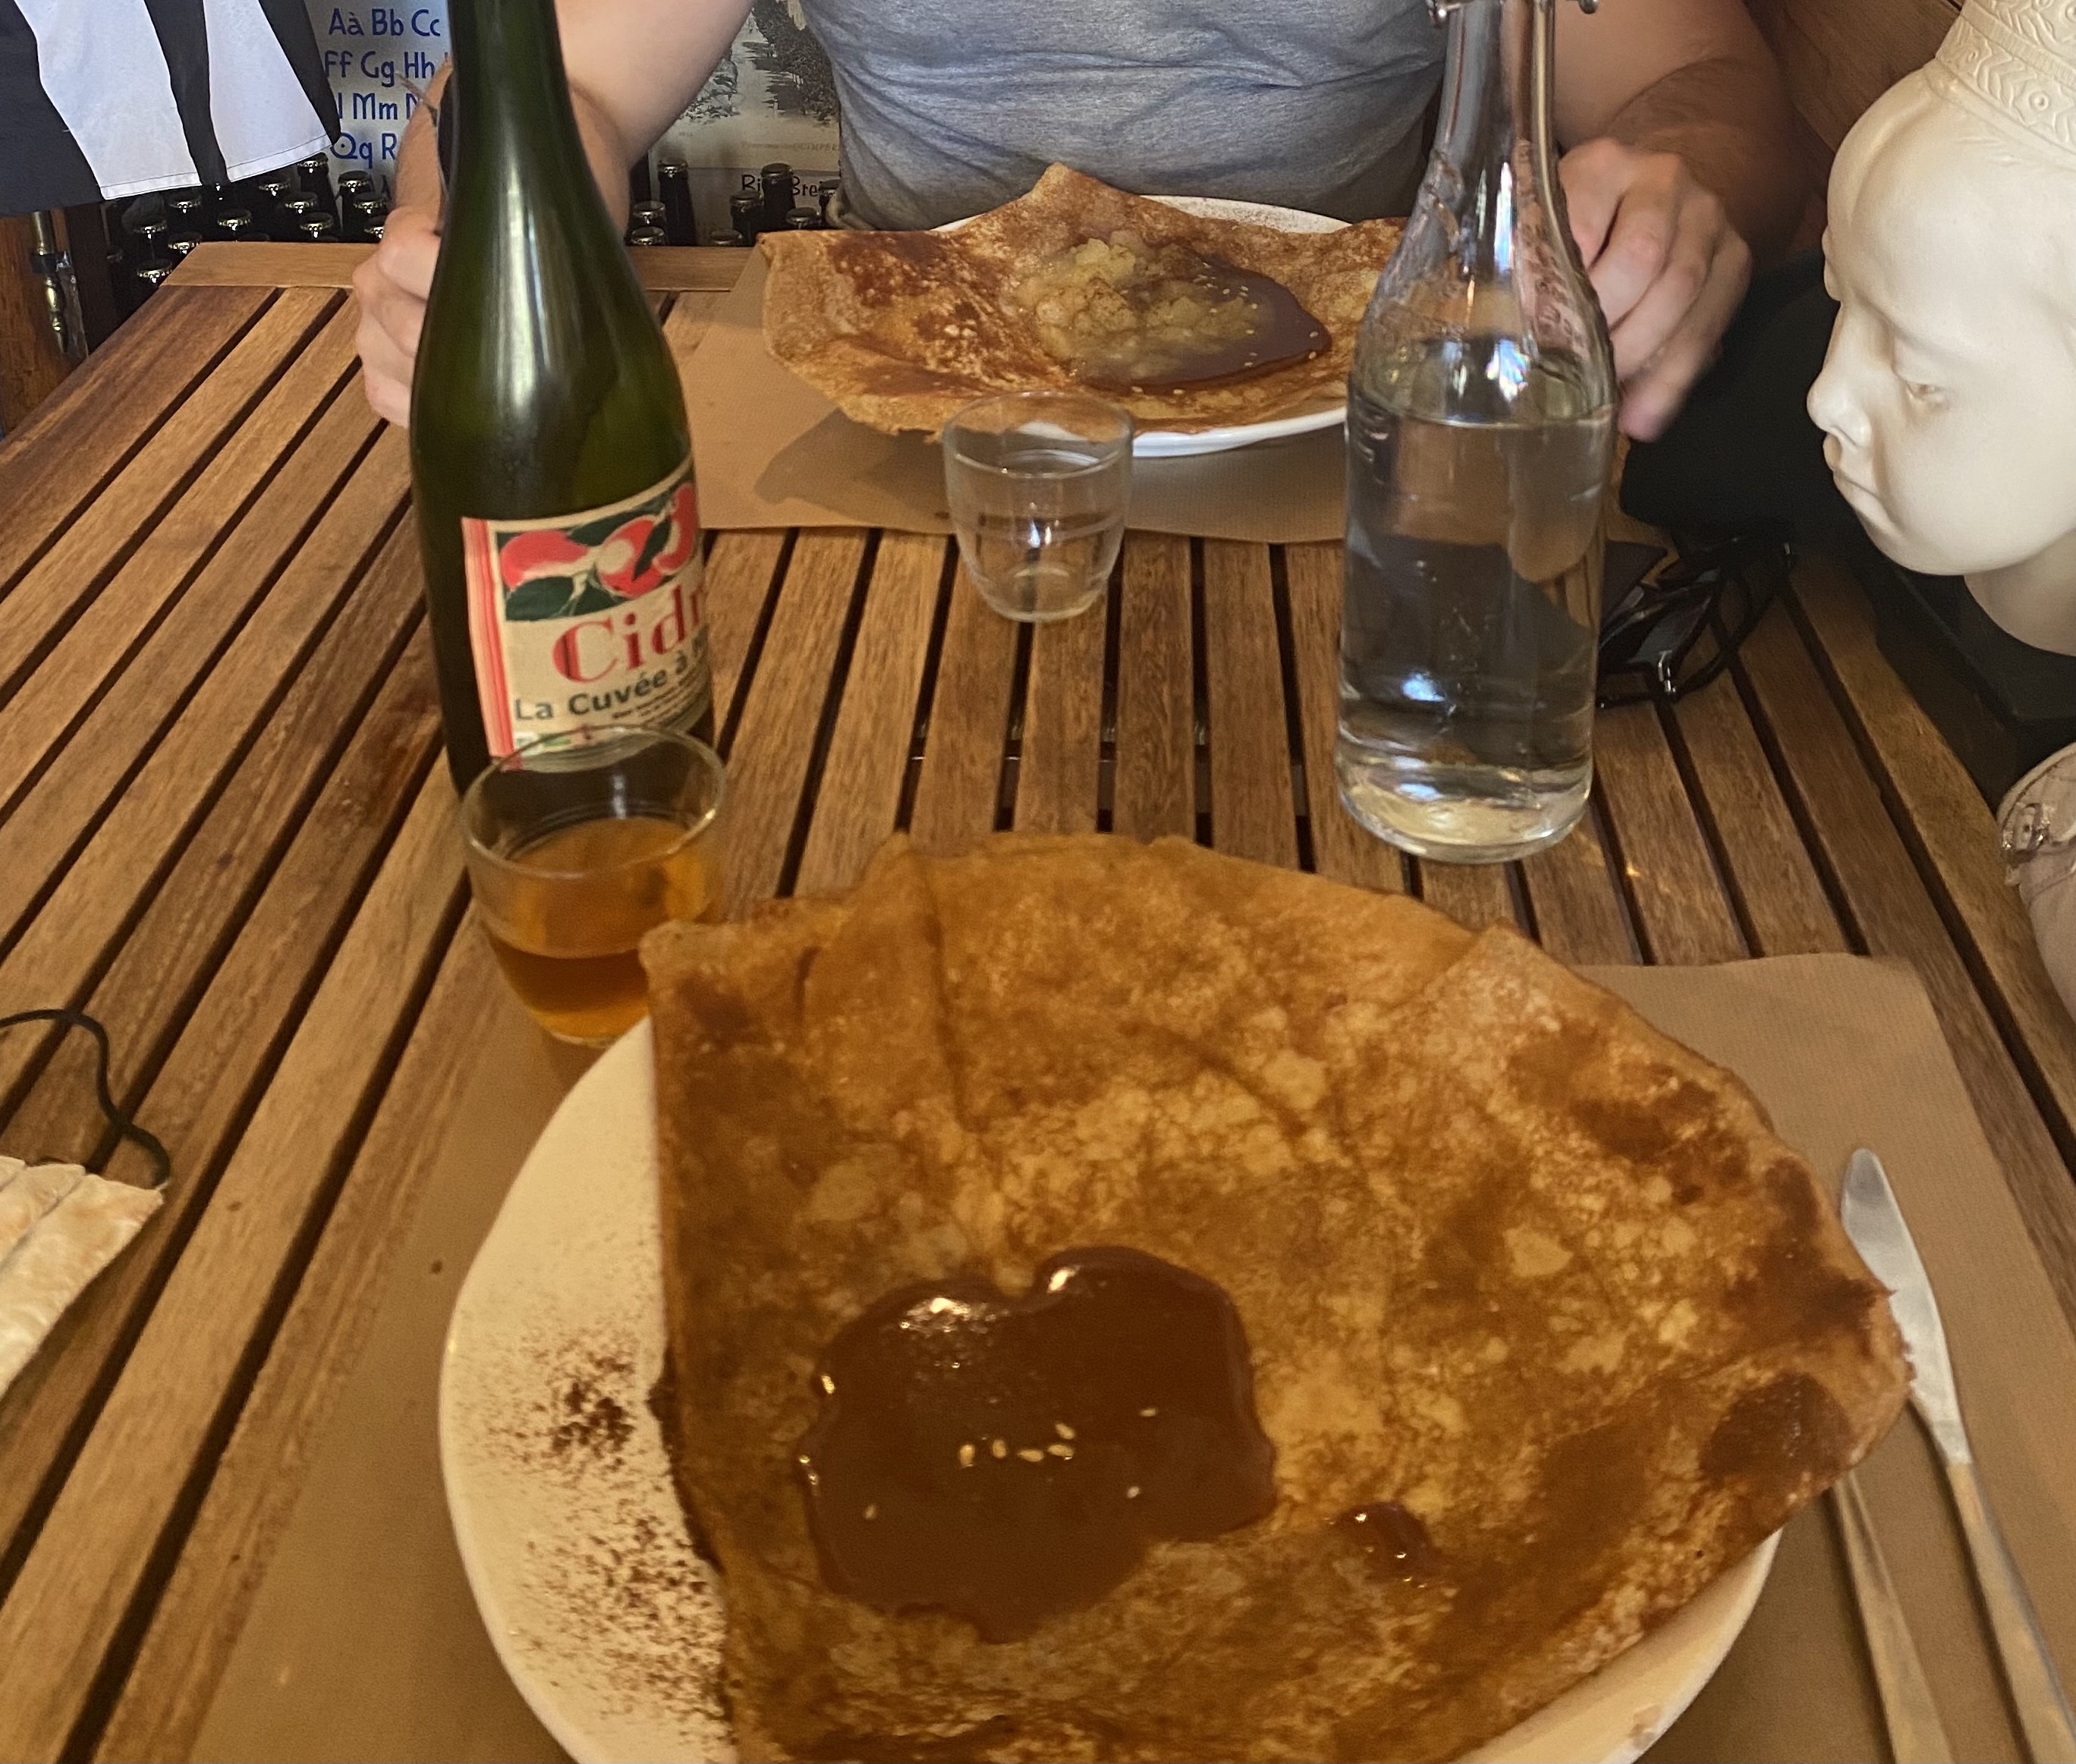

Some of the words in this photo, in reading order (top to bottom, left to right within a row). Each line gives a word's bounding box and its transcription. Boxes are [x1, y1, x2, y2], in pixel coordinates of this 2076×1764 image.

[372, 8, 404, 36] Bb
[411, 9, 441, 36] Cc
[324, 50, 353, 78] Ff
[360, 51, 395, 87] Gg
[404, 52, 436, 79] Hh
[353, 93, 398, 120] Mm
[329, 132, 373, 169] Qq
[791, 176, 820, 197] Bre
[515, 699, 554, 722] La
[569, 669, 668, 715] Cuvée
